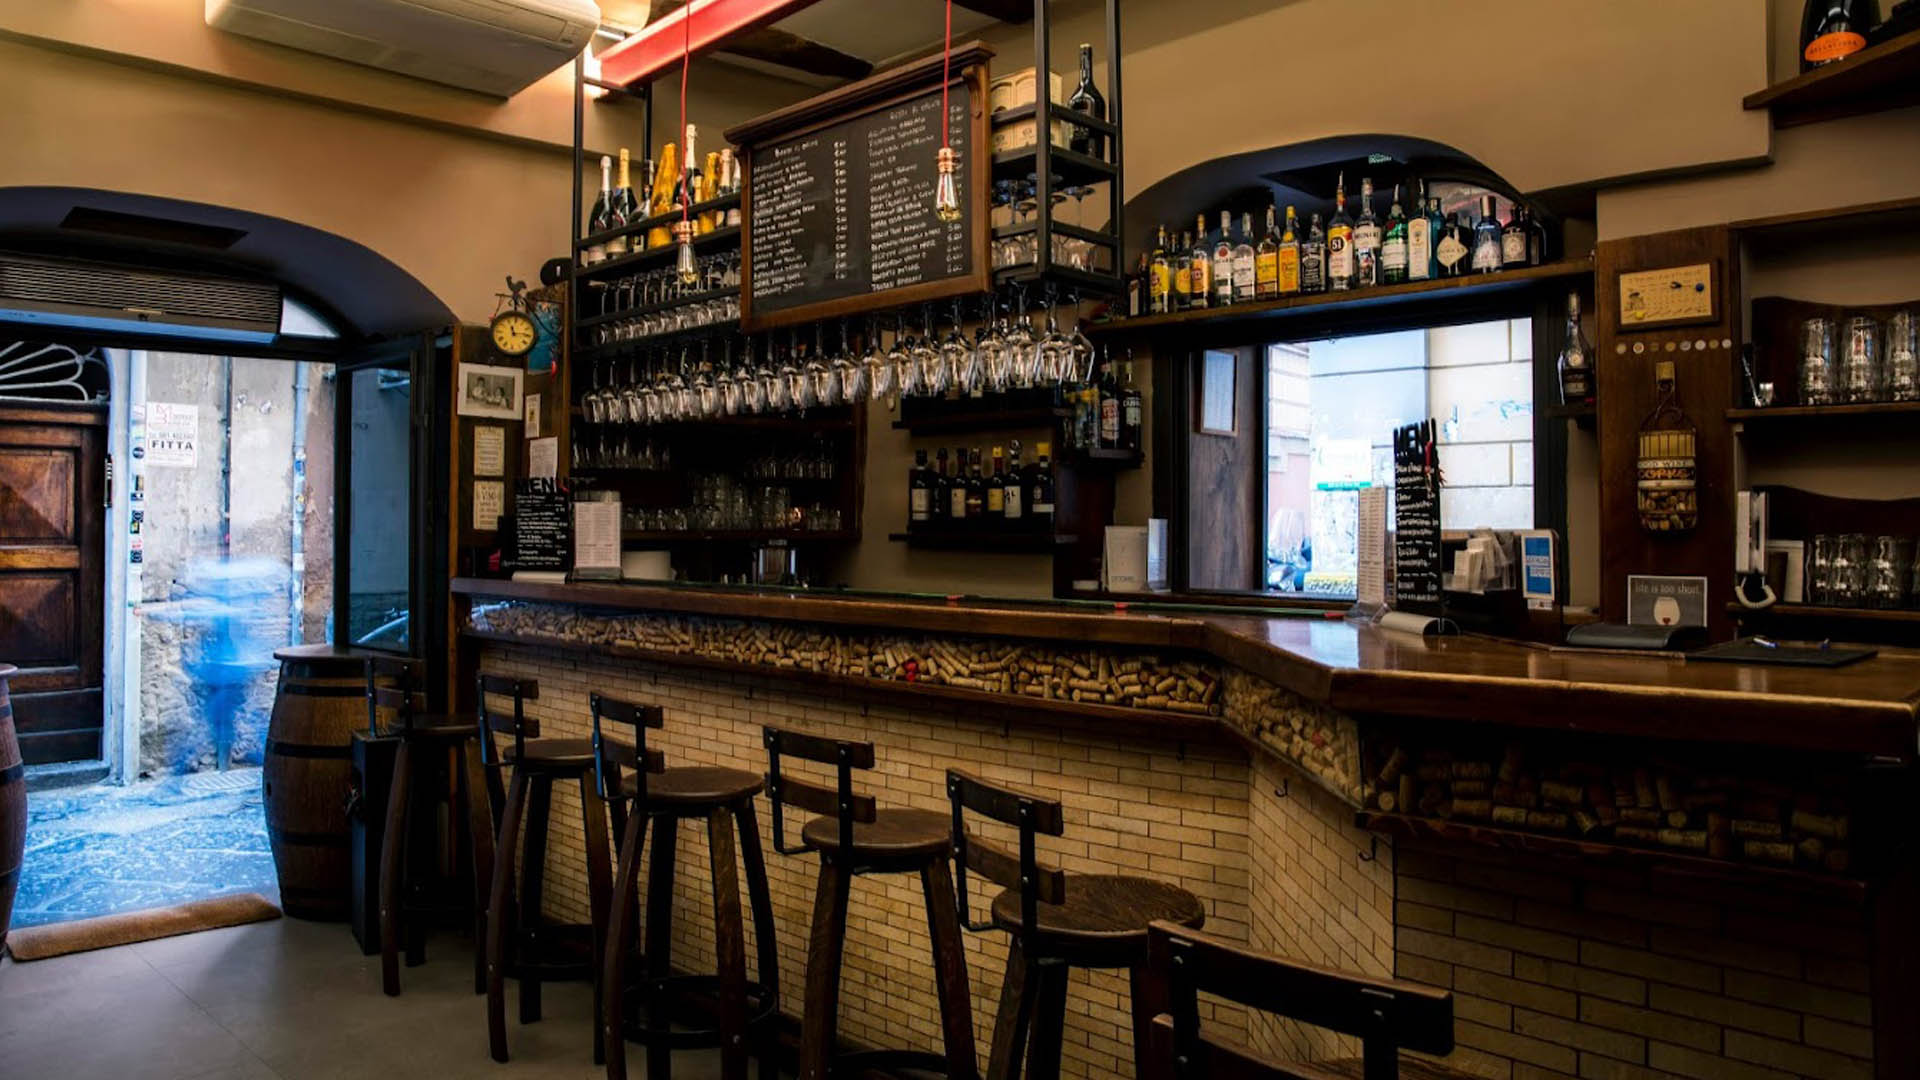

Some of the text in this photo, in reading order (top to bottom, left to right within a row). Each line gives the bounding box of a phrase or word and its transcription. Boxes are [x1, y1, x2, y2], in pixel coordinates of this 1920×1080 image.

[1332, 238, 1342, 250] 51
[152, 440, 194, 450] FITTA
[1661, 583, 1675, 593] too
